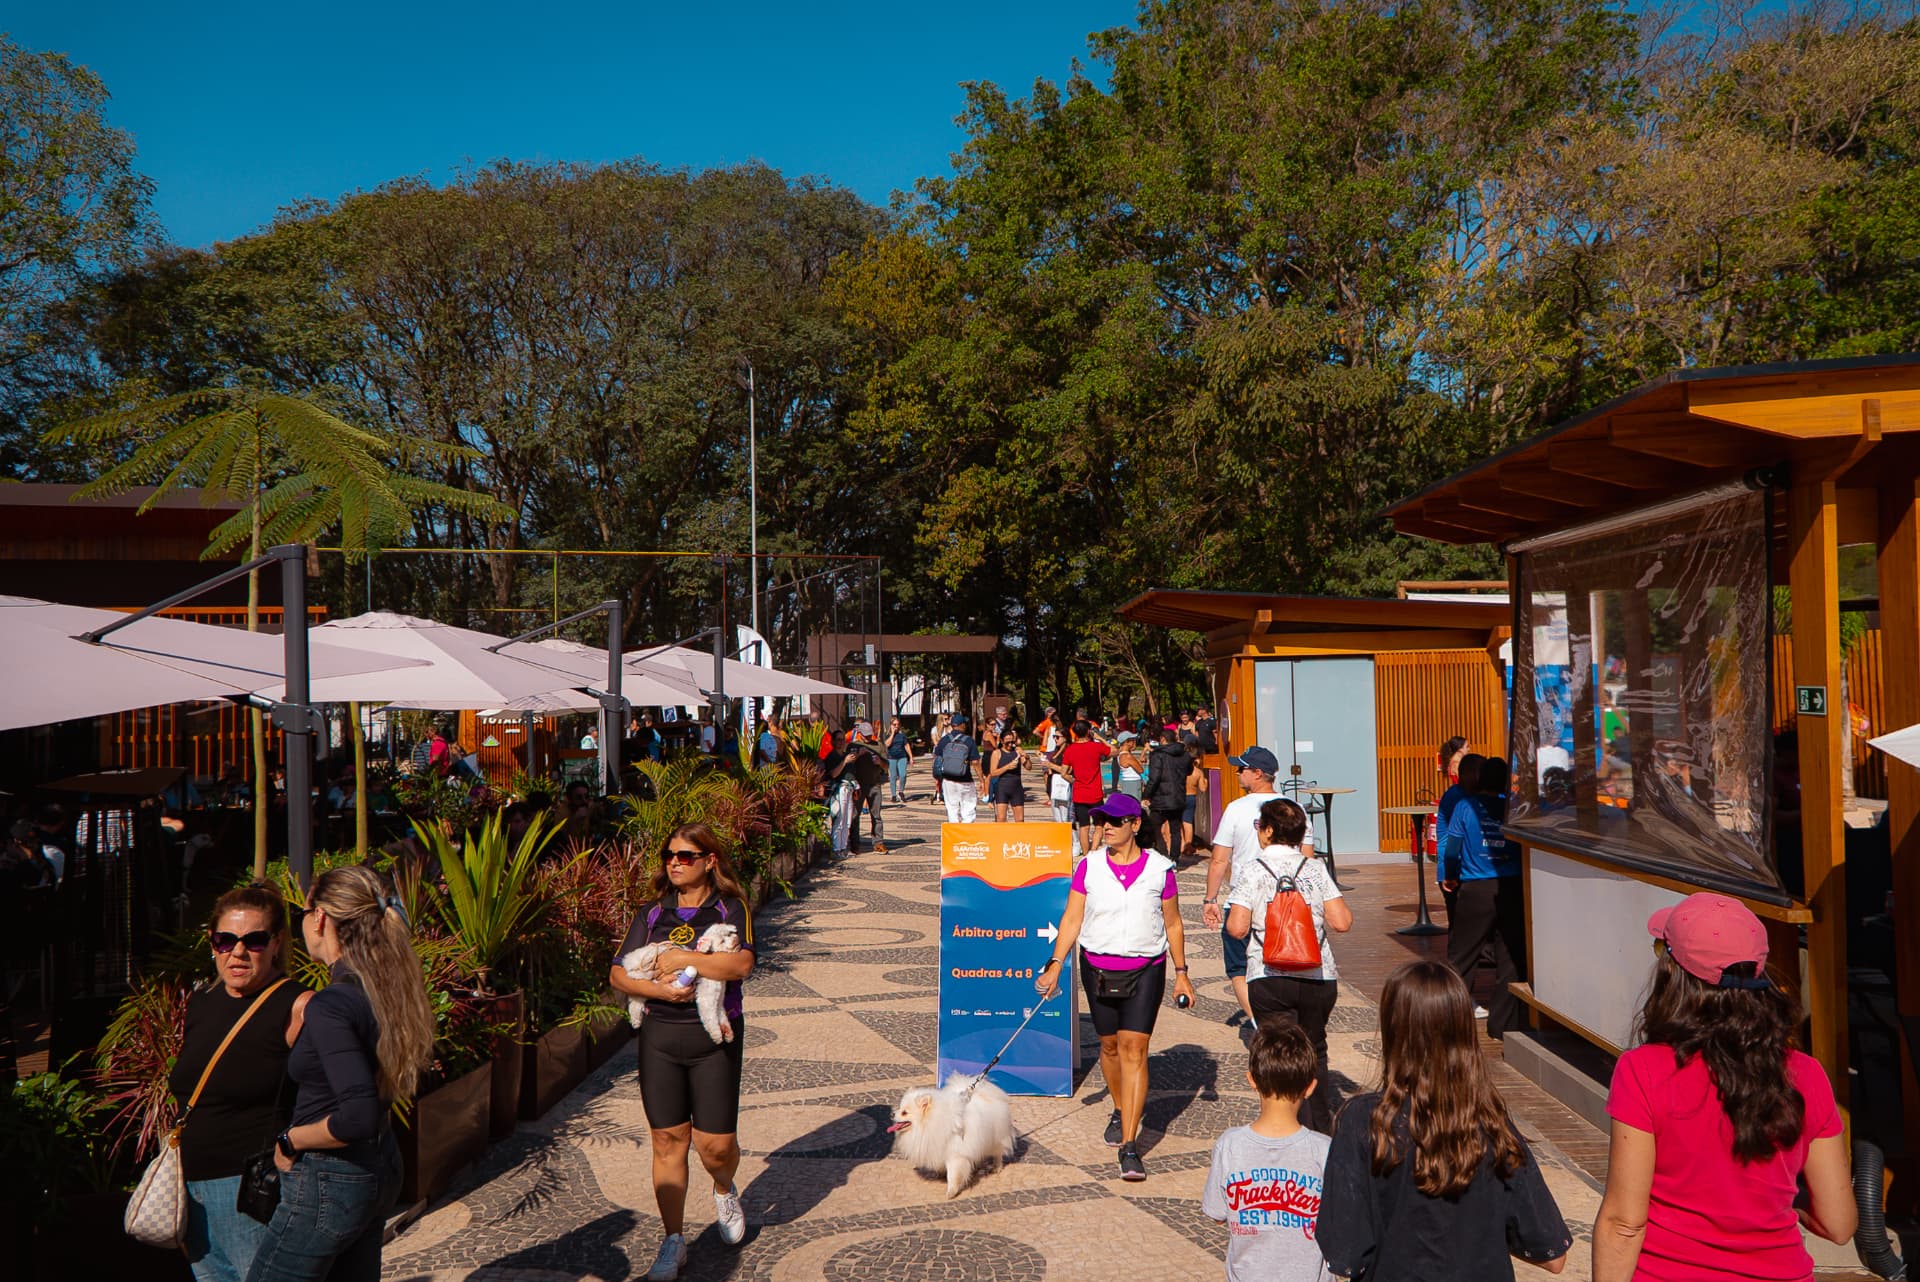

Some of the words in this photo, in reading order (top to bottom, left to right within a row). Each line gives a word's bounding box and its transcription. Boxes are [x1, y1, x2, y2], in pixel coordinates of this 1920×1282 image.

[952, 924, 993, 938] Árbitro
[995, 927, 1027, 941] geral
[951, 968, 1002, 978] Quadras
[1005, 968, 1012, 978] 4
[1015, 969, 1023, 978] a
[1025, 968, 1033, 978] 8
[1251, 1168, 1288, 1182] GOOD
